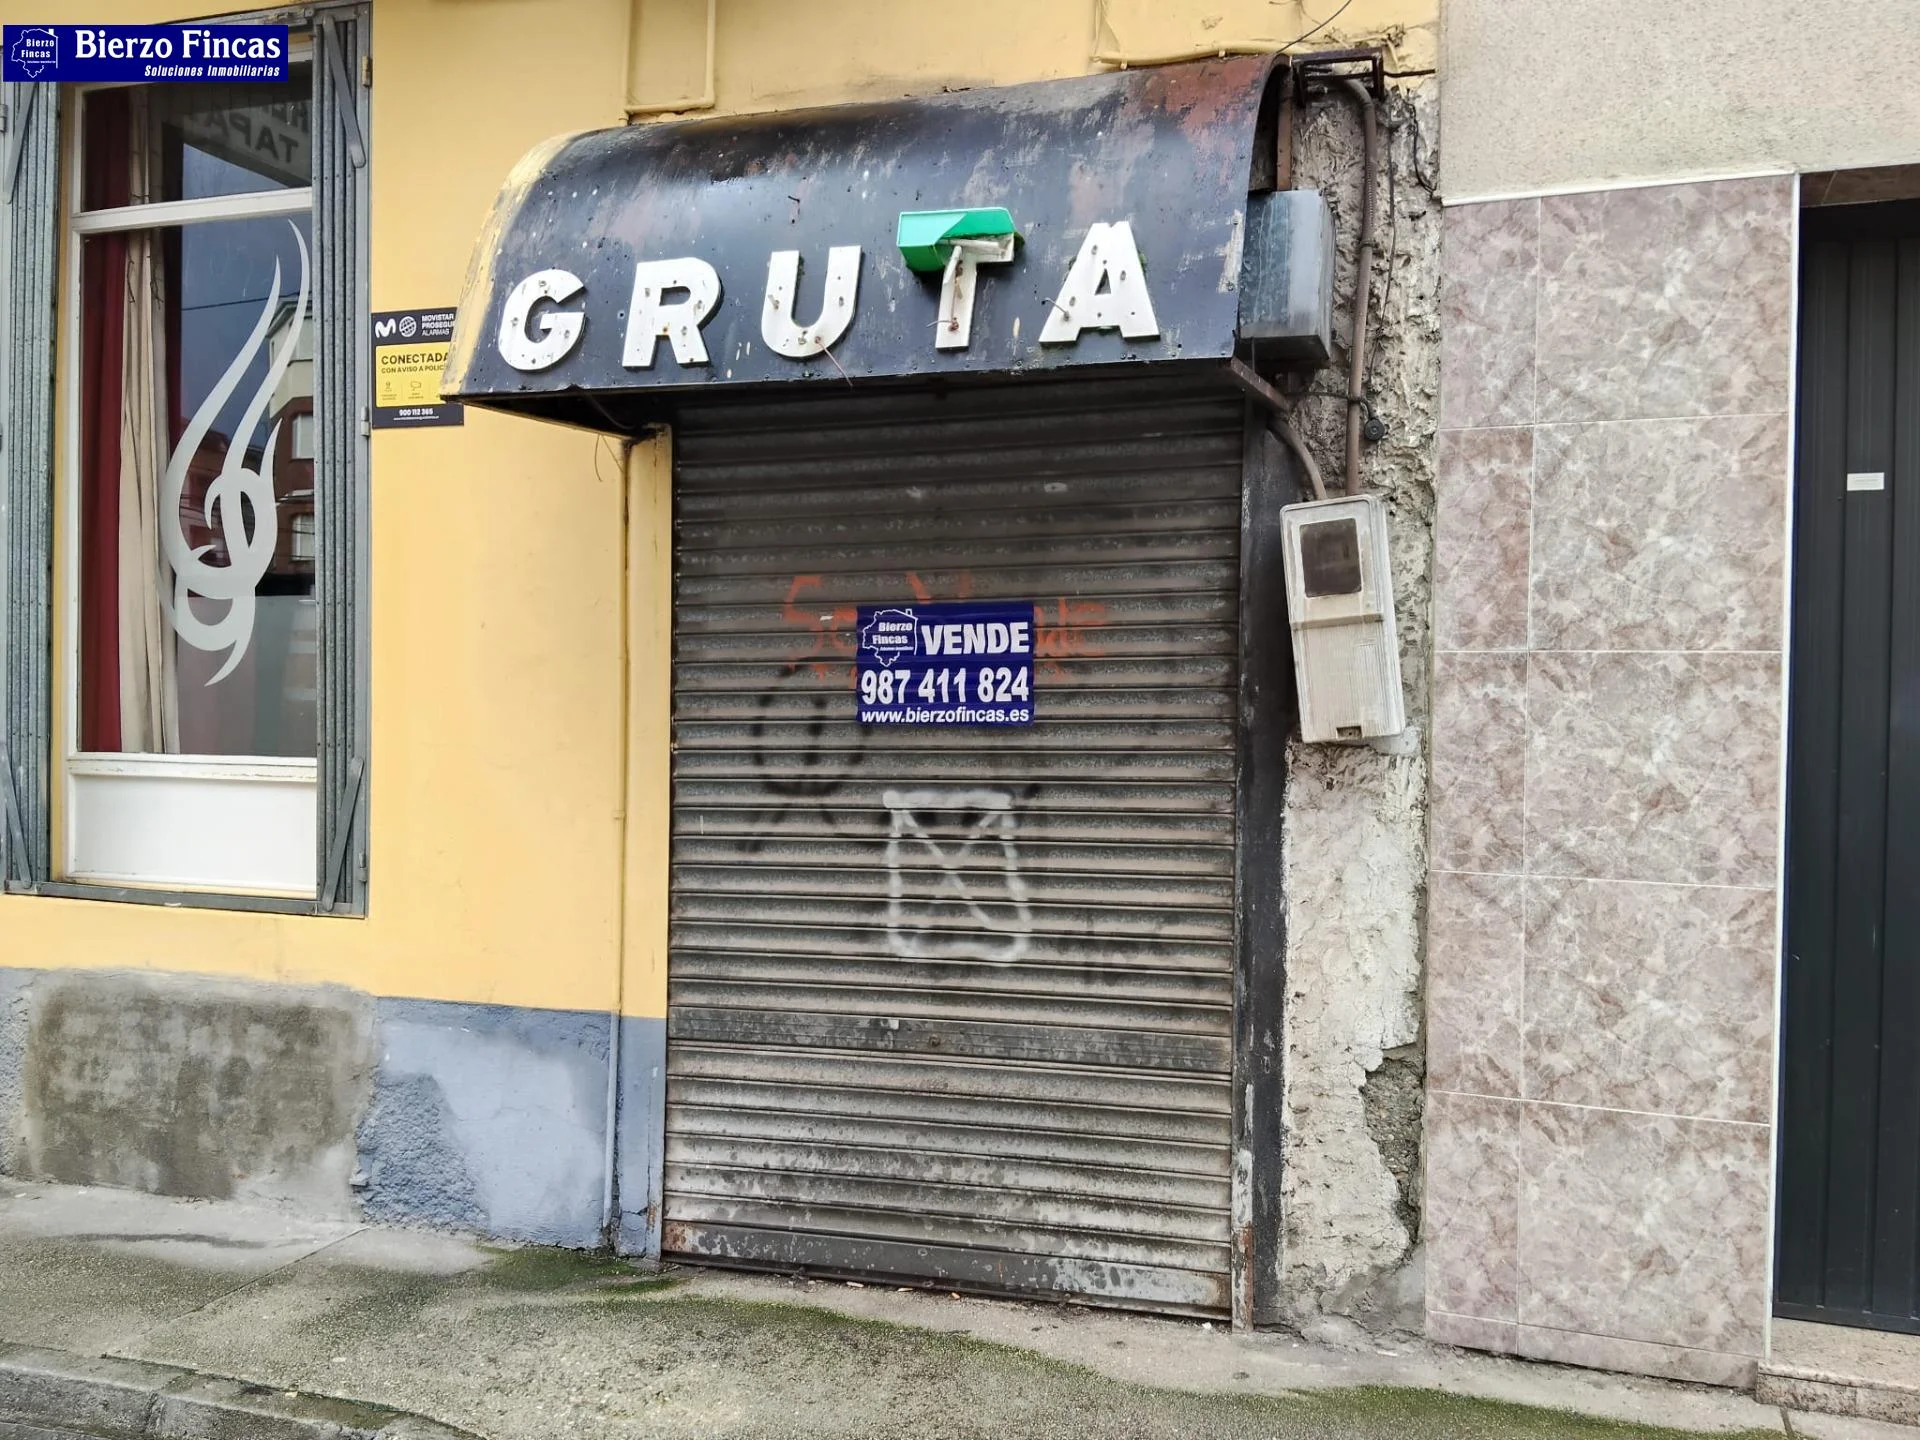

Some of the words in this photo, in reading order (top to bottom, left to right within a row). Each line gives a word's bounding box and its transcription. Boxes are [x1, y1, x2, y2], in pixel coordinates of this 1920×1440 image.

[498, 207, 1160, 371] GRUTA
[422, 313, 454, 322] MOVISTAR
[878, 622, 913, 632] Bierzo
[872, 634, 908, 644] Fincas
[920, 622, 1030, 655] VENDE
[861, 669, 911, 704] 987
[918, 667, 967, 704] 411
[977, 666, 1029, 702] 824
[861, 706, 1029, 724] www.bierzofincas.es
